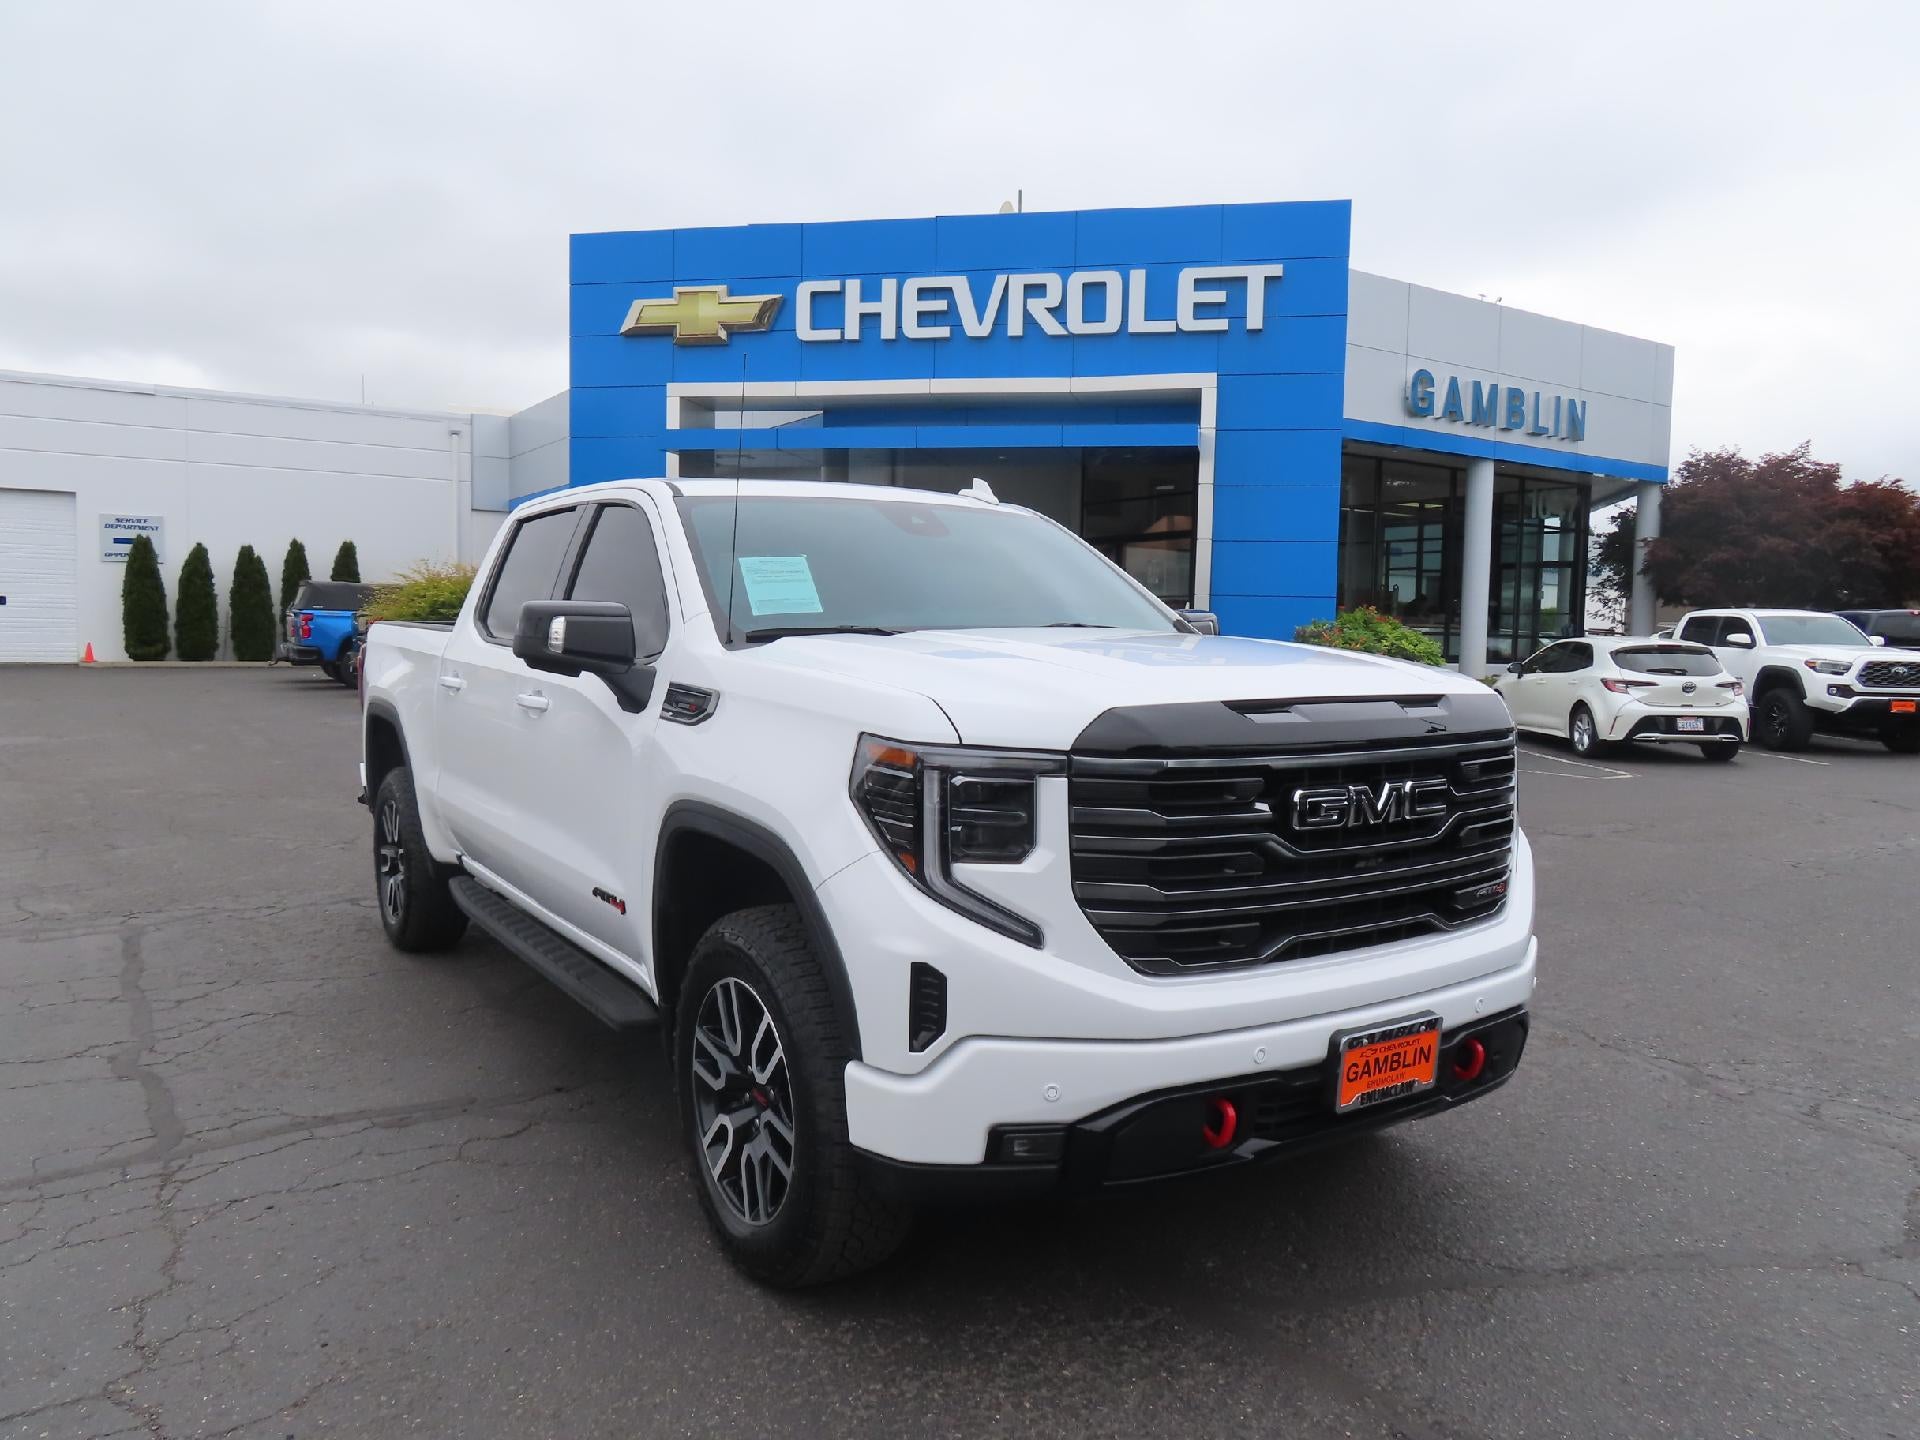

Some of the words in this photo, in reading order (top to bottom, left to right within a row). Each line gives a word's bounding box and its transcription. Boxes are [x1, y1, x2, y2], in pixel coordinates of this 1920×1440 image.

[795, 263, 1284, 343] CHEVROLET
[1406, 368, 1587, 441] GAMBLIN
[103, 523, 160, 531] DEPARTMENT
[1292, 778, 1448, 831] GMC
[1346, 1044, 1432, 1083] GAMBLIN
[1378, 1038, 1421, 1054] CHEVROLET
